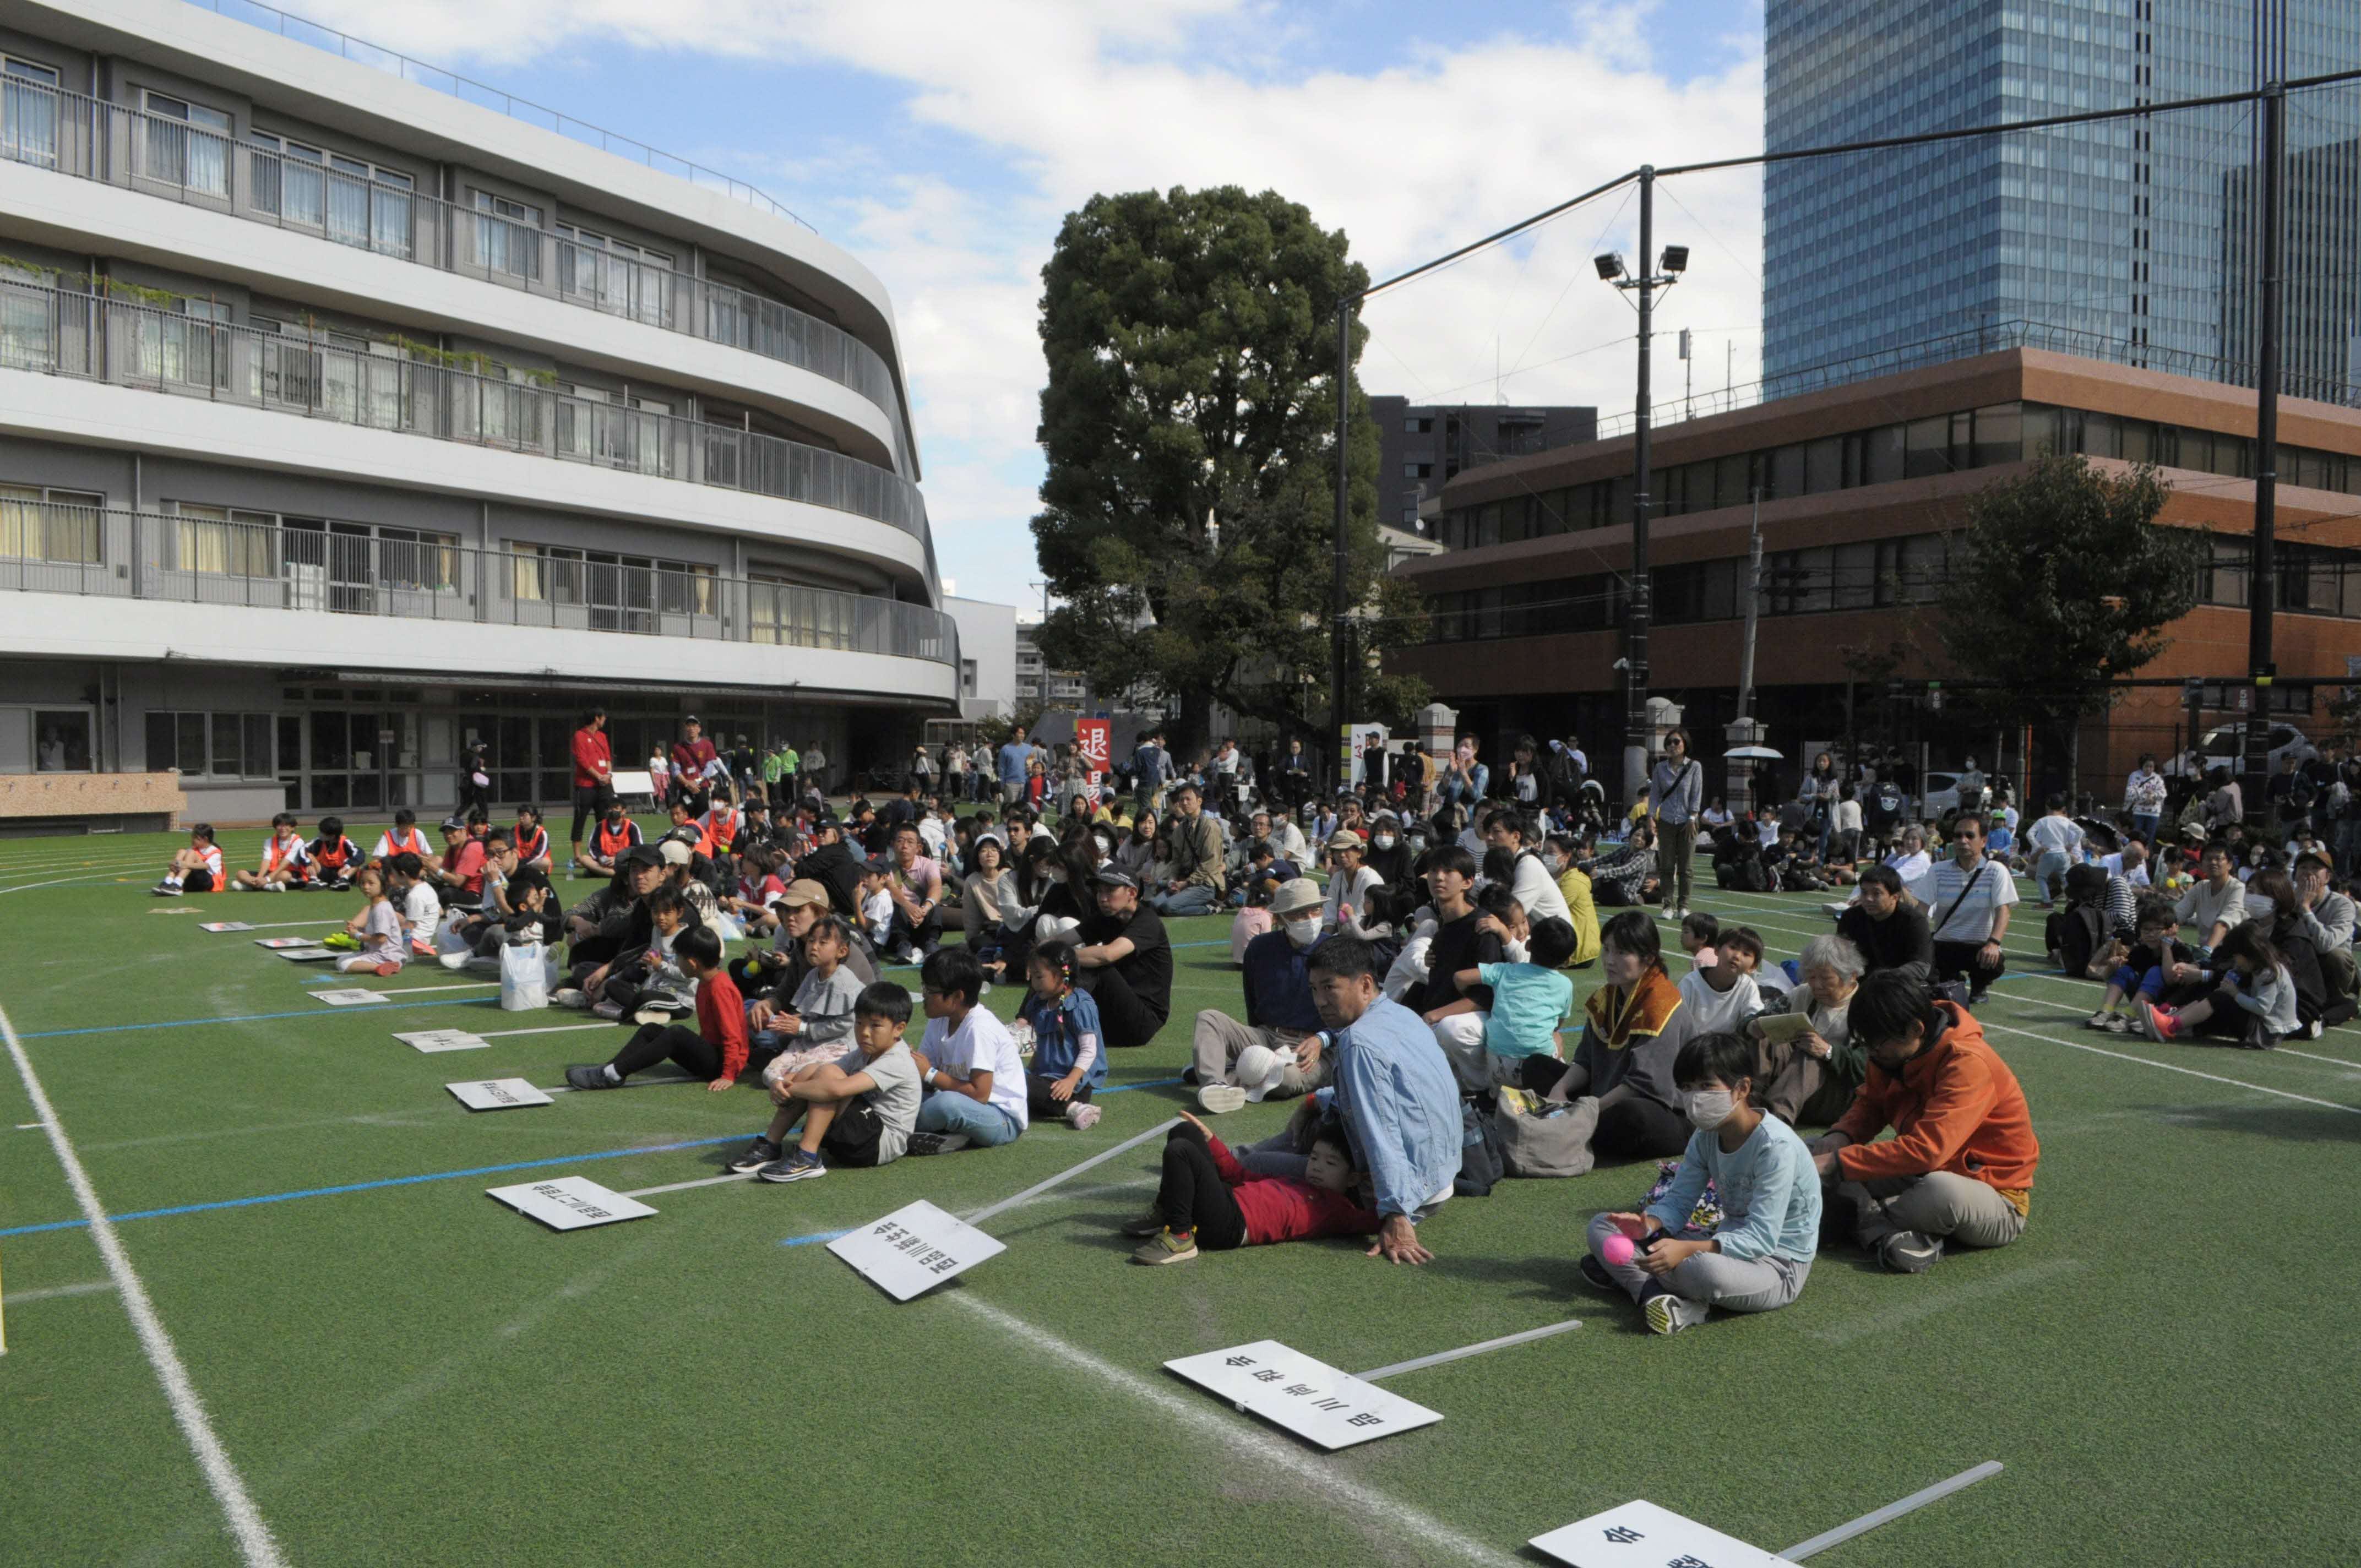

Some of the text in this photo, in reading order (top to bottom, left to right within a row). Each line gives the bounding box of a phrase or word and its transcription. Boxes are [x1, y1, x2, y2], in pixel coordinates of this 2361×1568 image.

[873, 1222, 959, 1274] 西品川新生会
[1226, 1355, 1385, 1427] 品川尚和会
